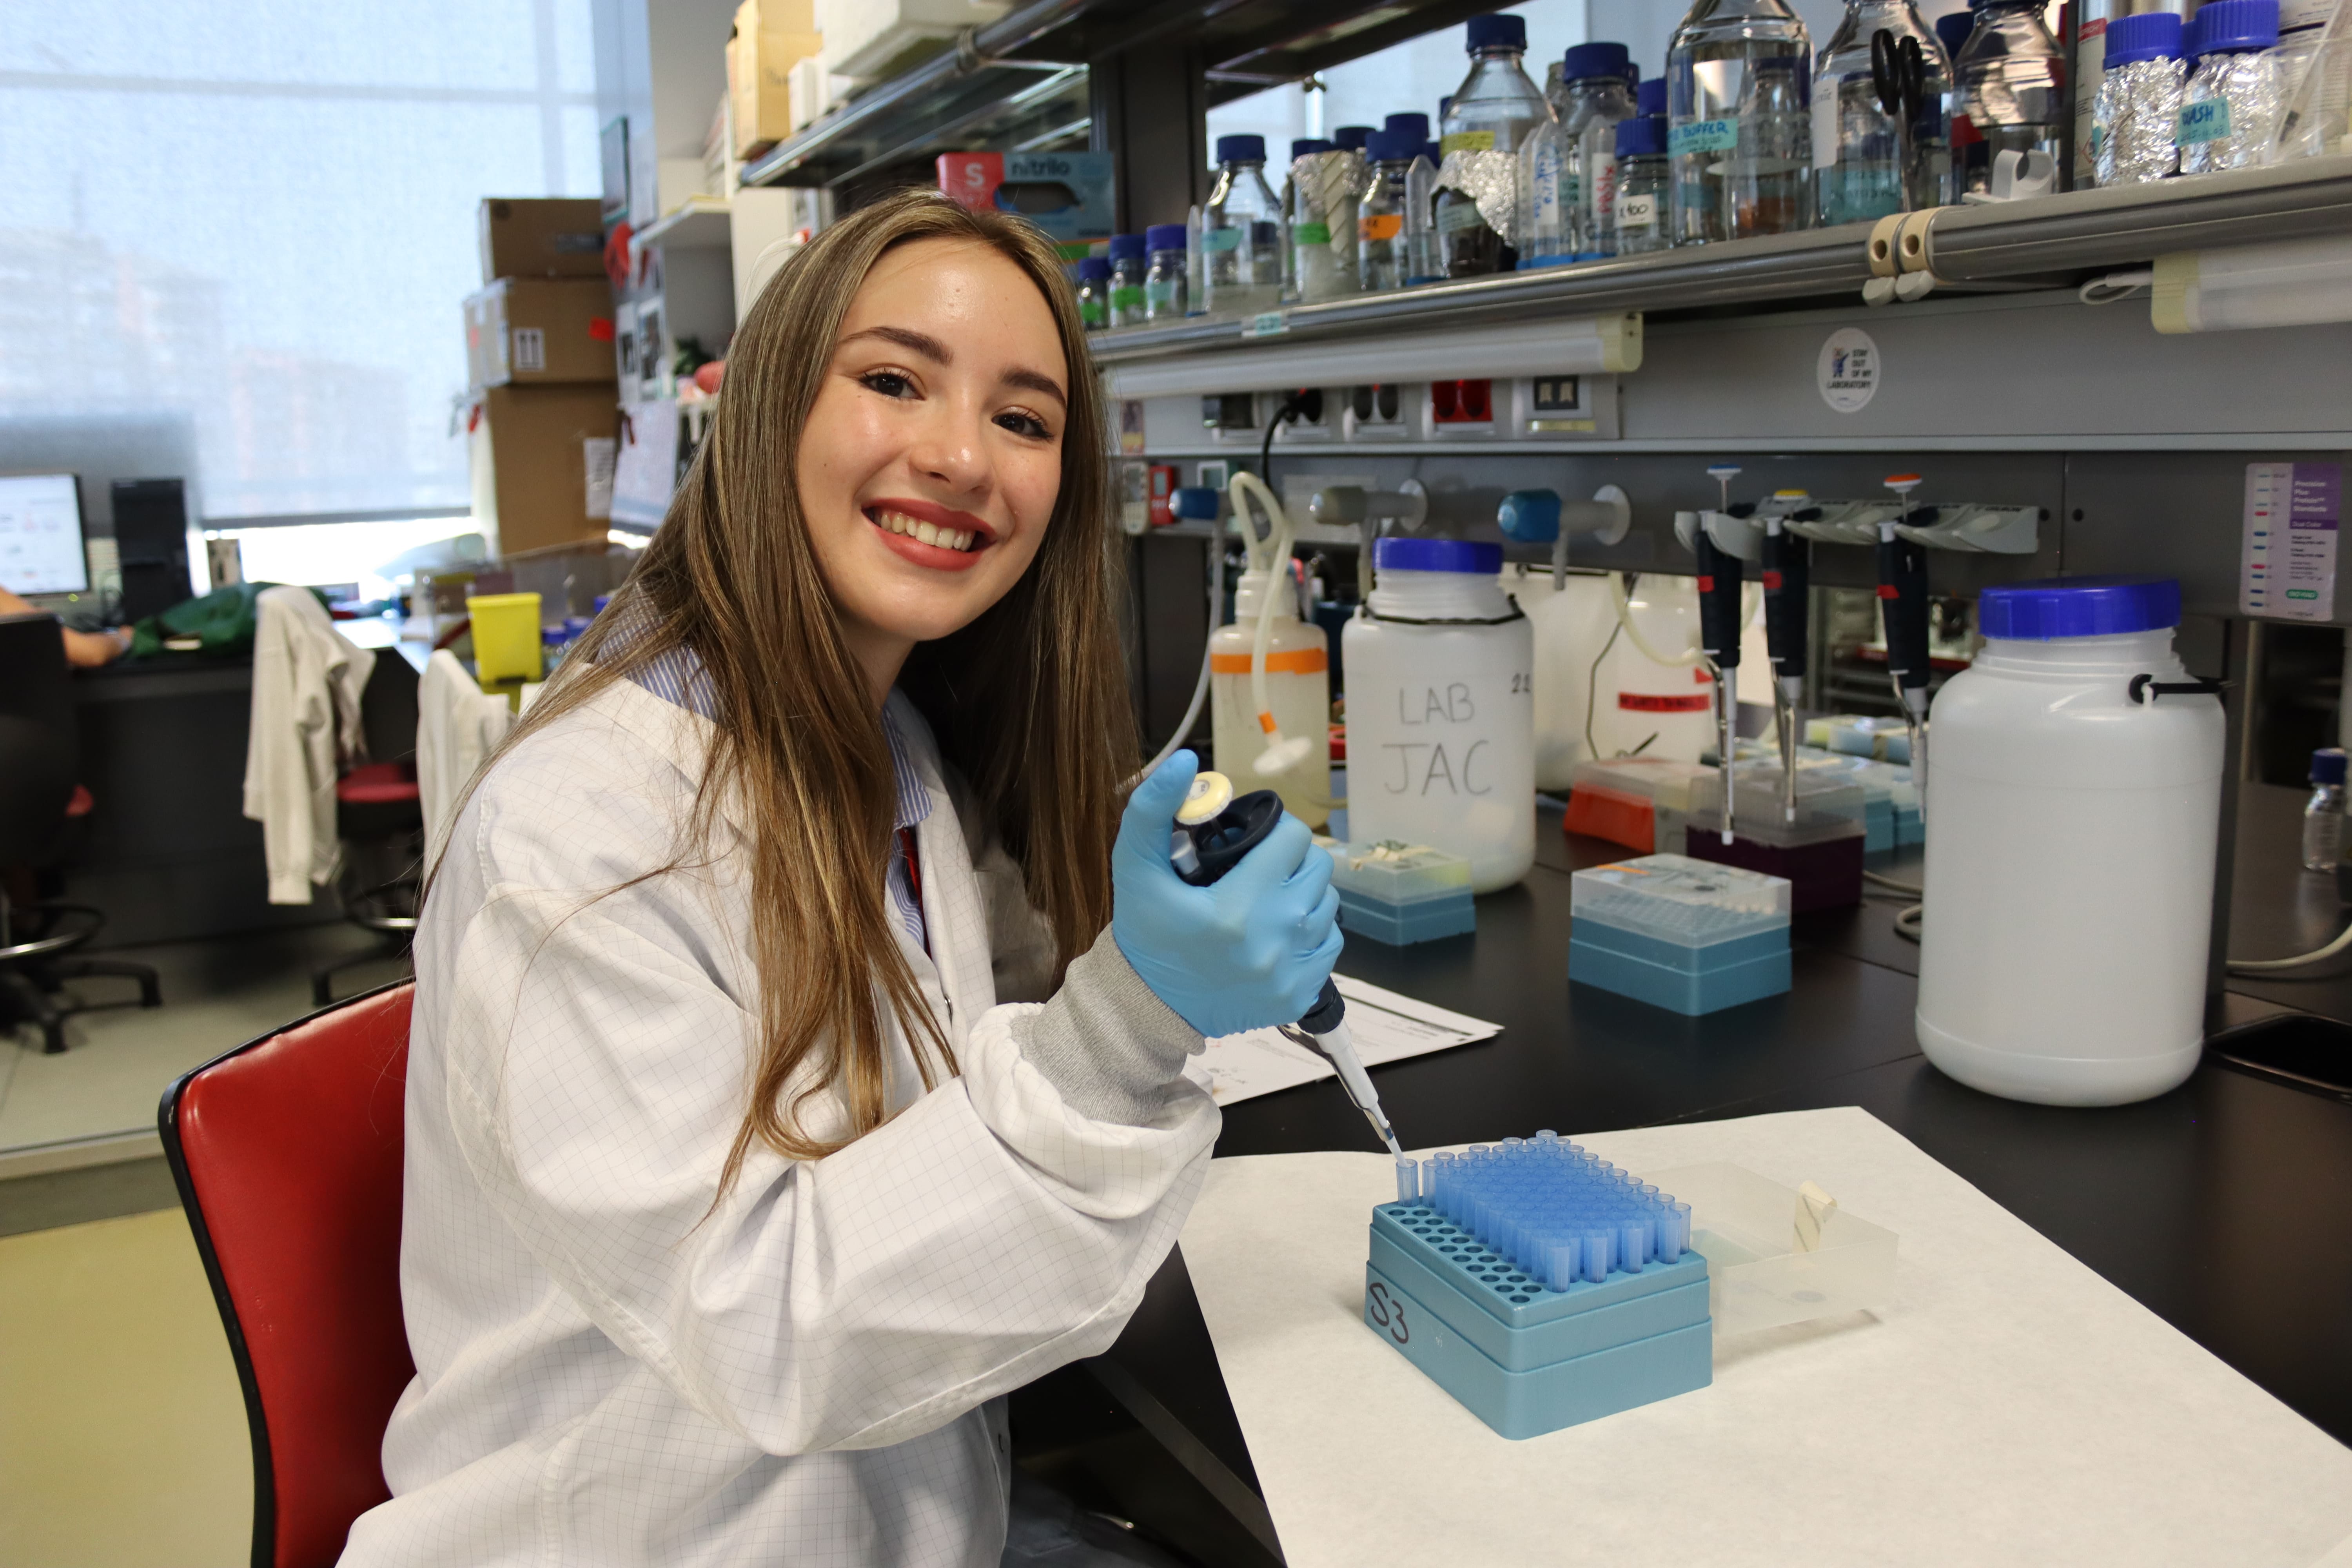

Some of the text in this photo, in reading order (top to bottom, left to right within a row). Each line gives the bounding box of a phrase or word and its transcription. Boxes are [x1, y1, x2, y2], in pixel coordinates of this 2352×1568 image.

[2182, 105, 2214, 126] WASH
[965, 162, 985, 187] S
[1011, 158, 1071, 176] nitrilo
[1852, 359, 1866, 367] OUT
[1853, 348, 1868, 357] STAY
[1827, 380, 1871, 389] LABORATORY
[1398, 682, 1475, 725] LAB
[1381, 739, 1492, 796] JAC
[1369, 1282, 1409, 1344] S3
